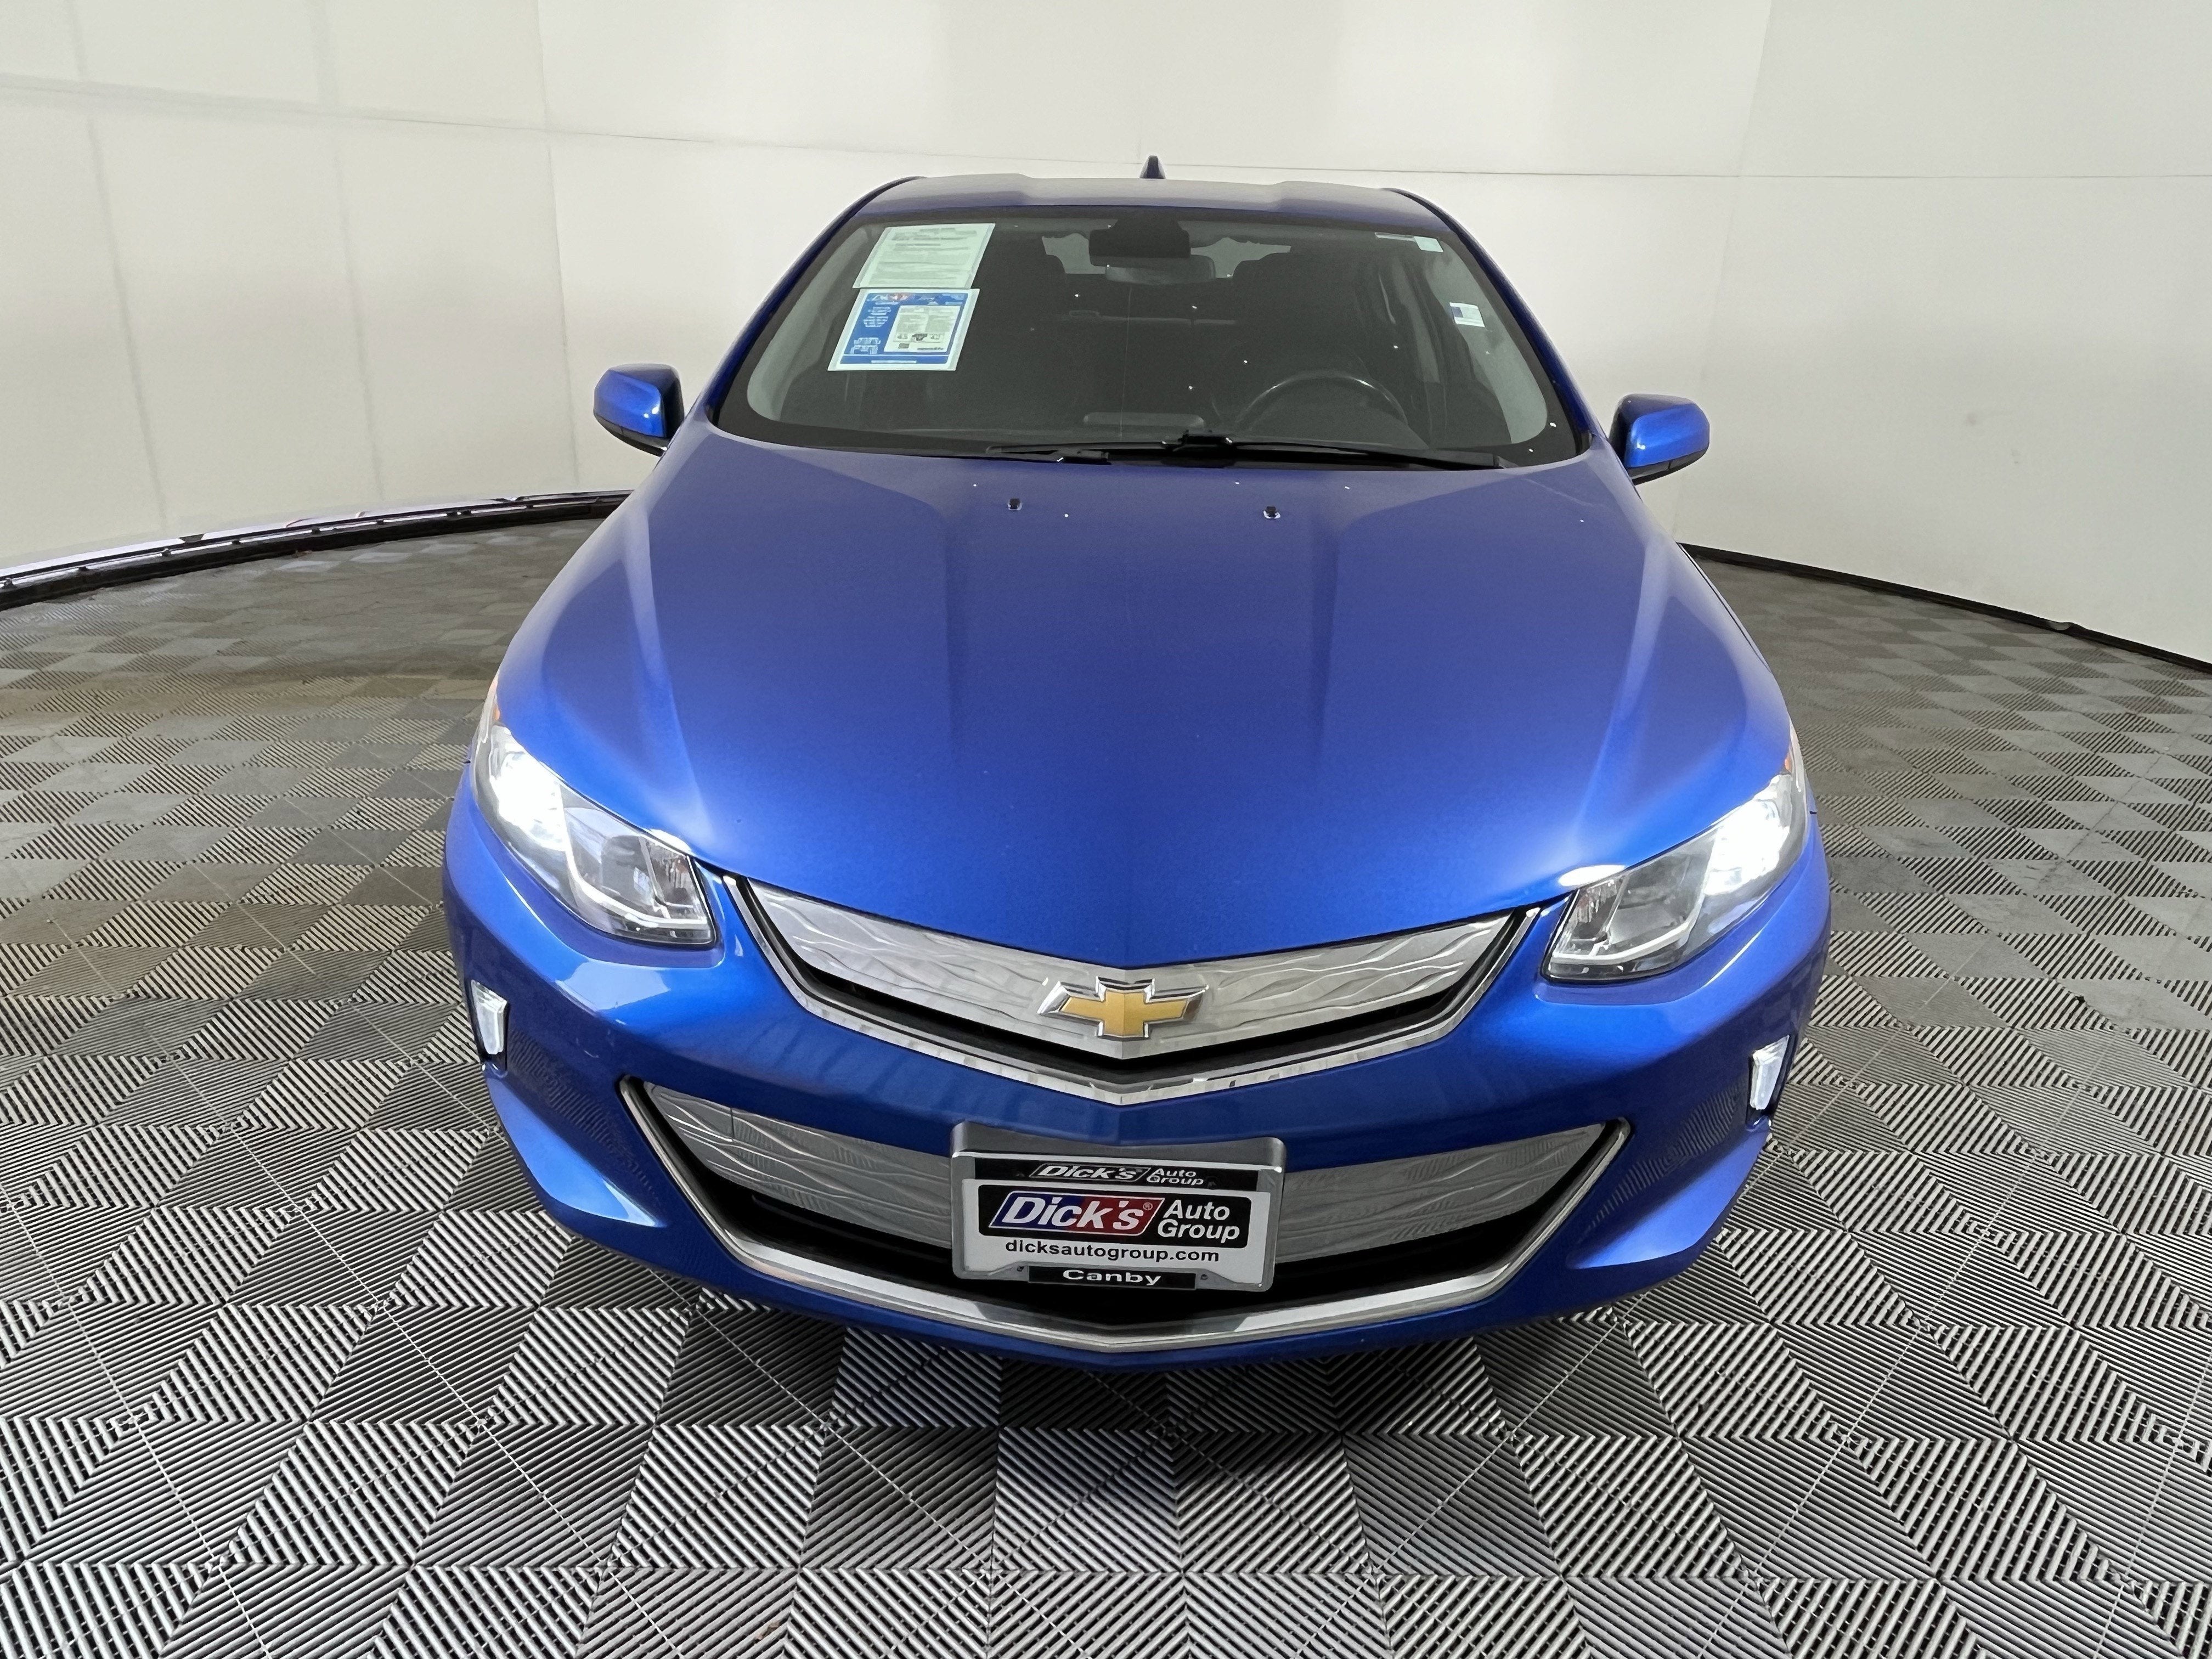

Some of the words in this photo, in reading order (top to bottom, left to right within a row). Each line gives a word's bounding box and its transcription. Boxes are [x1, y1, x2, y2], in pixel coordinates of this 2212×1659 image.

[1037, 1165, 1137, 1180] Dick's
[1147, 1175, 1204, 1186] Group
[1151, 1168, 1197, 1177] Auto
[1001, 1196, 1144, 1231] Dick's
[1163, 1199, 1230, 1220] Auto
[1158, 1219, 1240, 1243] Group
[1005, 1240, 1220, 1262] dicksautogroup.com
[1063, 1269, 1161, 1286] Canby
